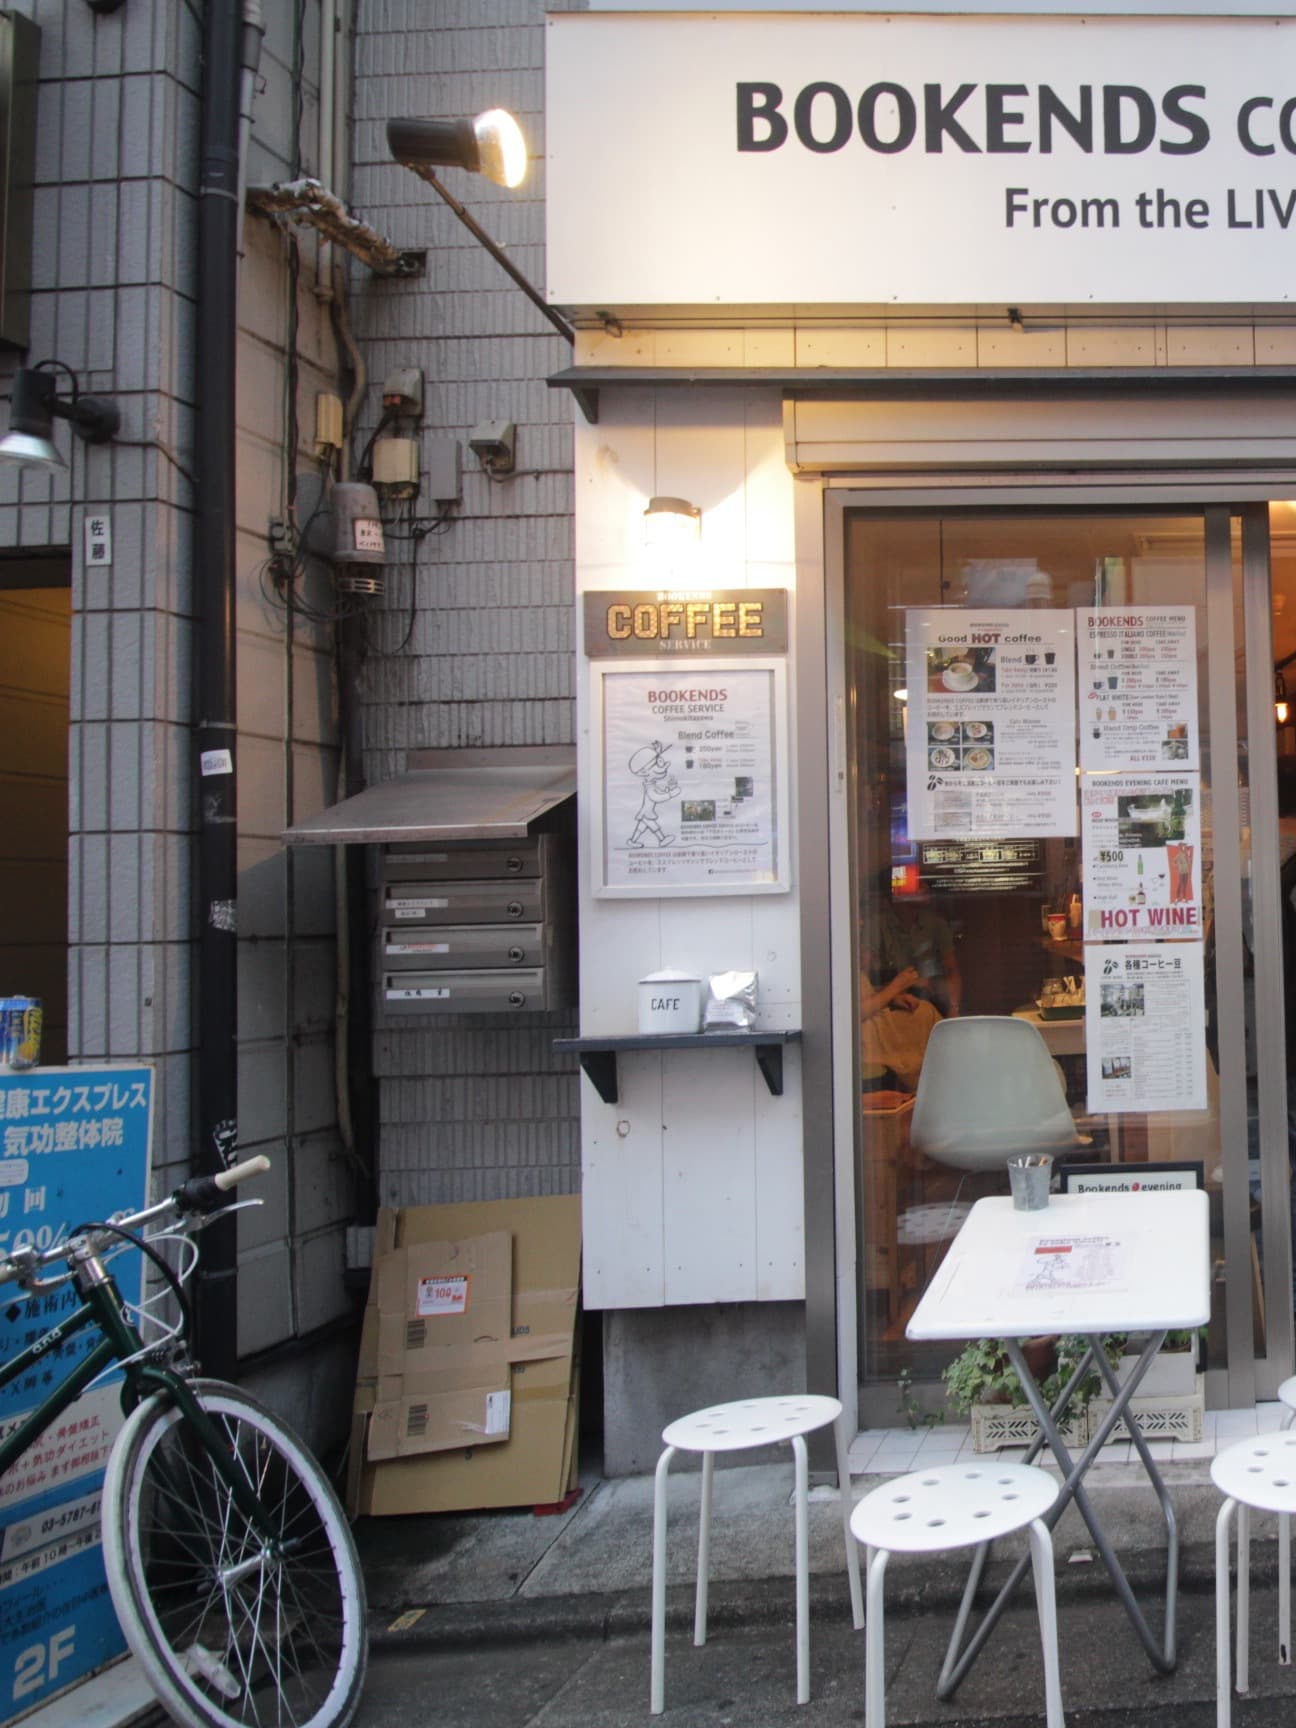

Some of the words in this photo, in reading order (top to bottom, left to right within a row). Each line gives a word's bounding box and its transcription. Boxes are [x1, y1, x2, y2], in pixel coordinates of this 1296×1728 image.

[735, 81, 1211, 156] BOOKENDS
[1004, 188, 1120, 229] From
[1135, 189, 1210, 229] the
[607, 602, 764, 640] COFFEE
[1088, 616, 1144, 627] BOOKENDS
[659, 640, 712, 650] SERVICE
[938, 635, 968, 643] Good
[971, 633, 1001, 644] HOT
[1004, 634, 1042, 643] coffee
[648, 689, 728, 703] BOOKENDS
[652, 705, 685, 714] COFFEE
[688, 703, 725, 713] SERVICE
[704, 730, 735, 739] Coffee
[1099, 851, 1124, 862] ¥500
[1101, 908, 1140, 928] HOT
[1147, 907, 1197, 926] WINE
[651, 998, 681, 1011] CAFE
[4, 1117, 124, 1157] 気功整体院
[13, 1624, 76, 1700] 2F
